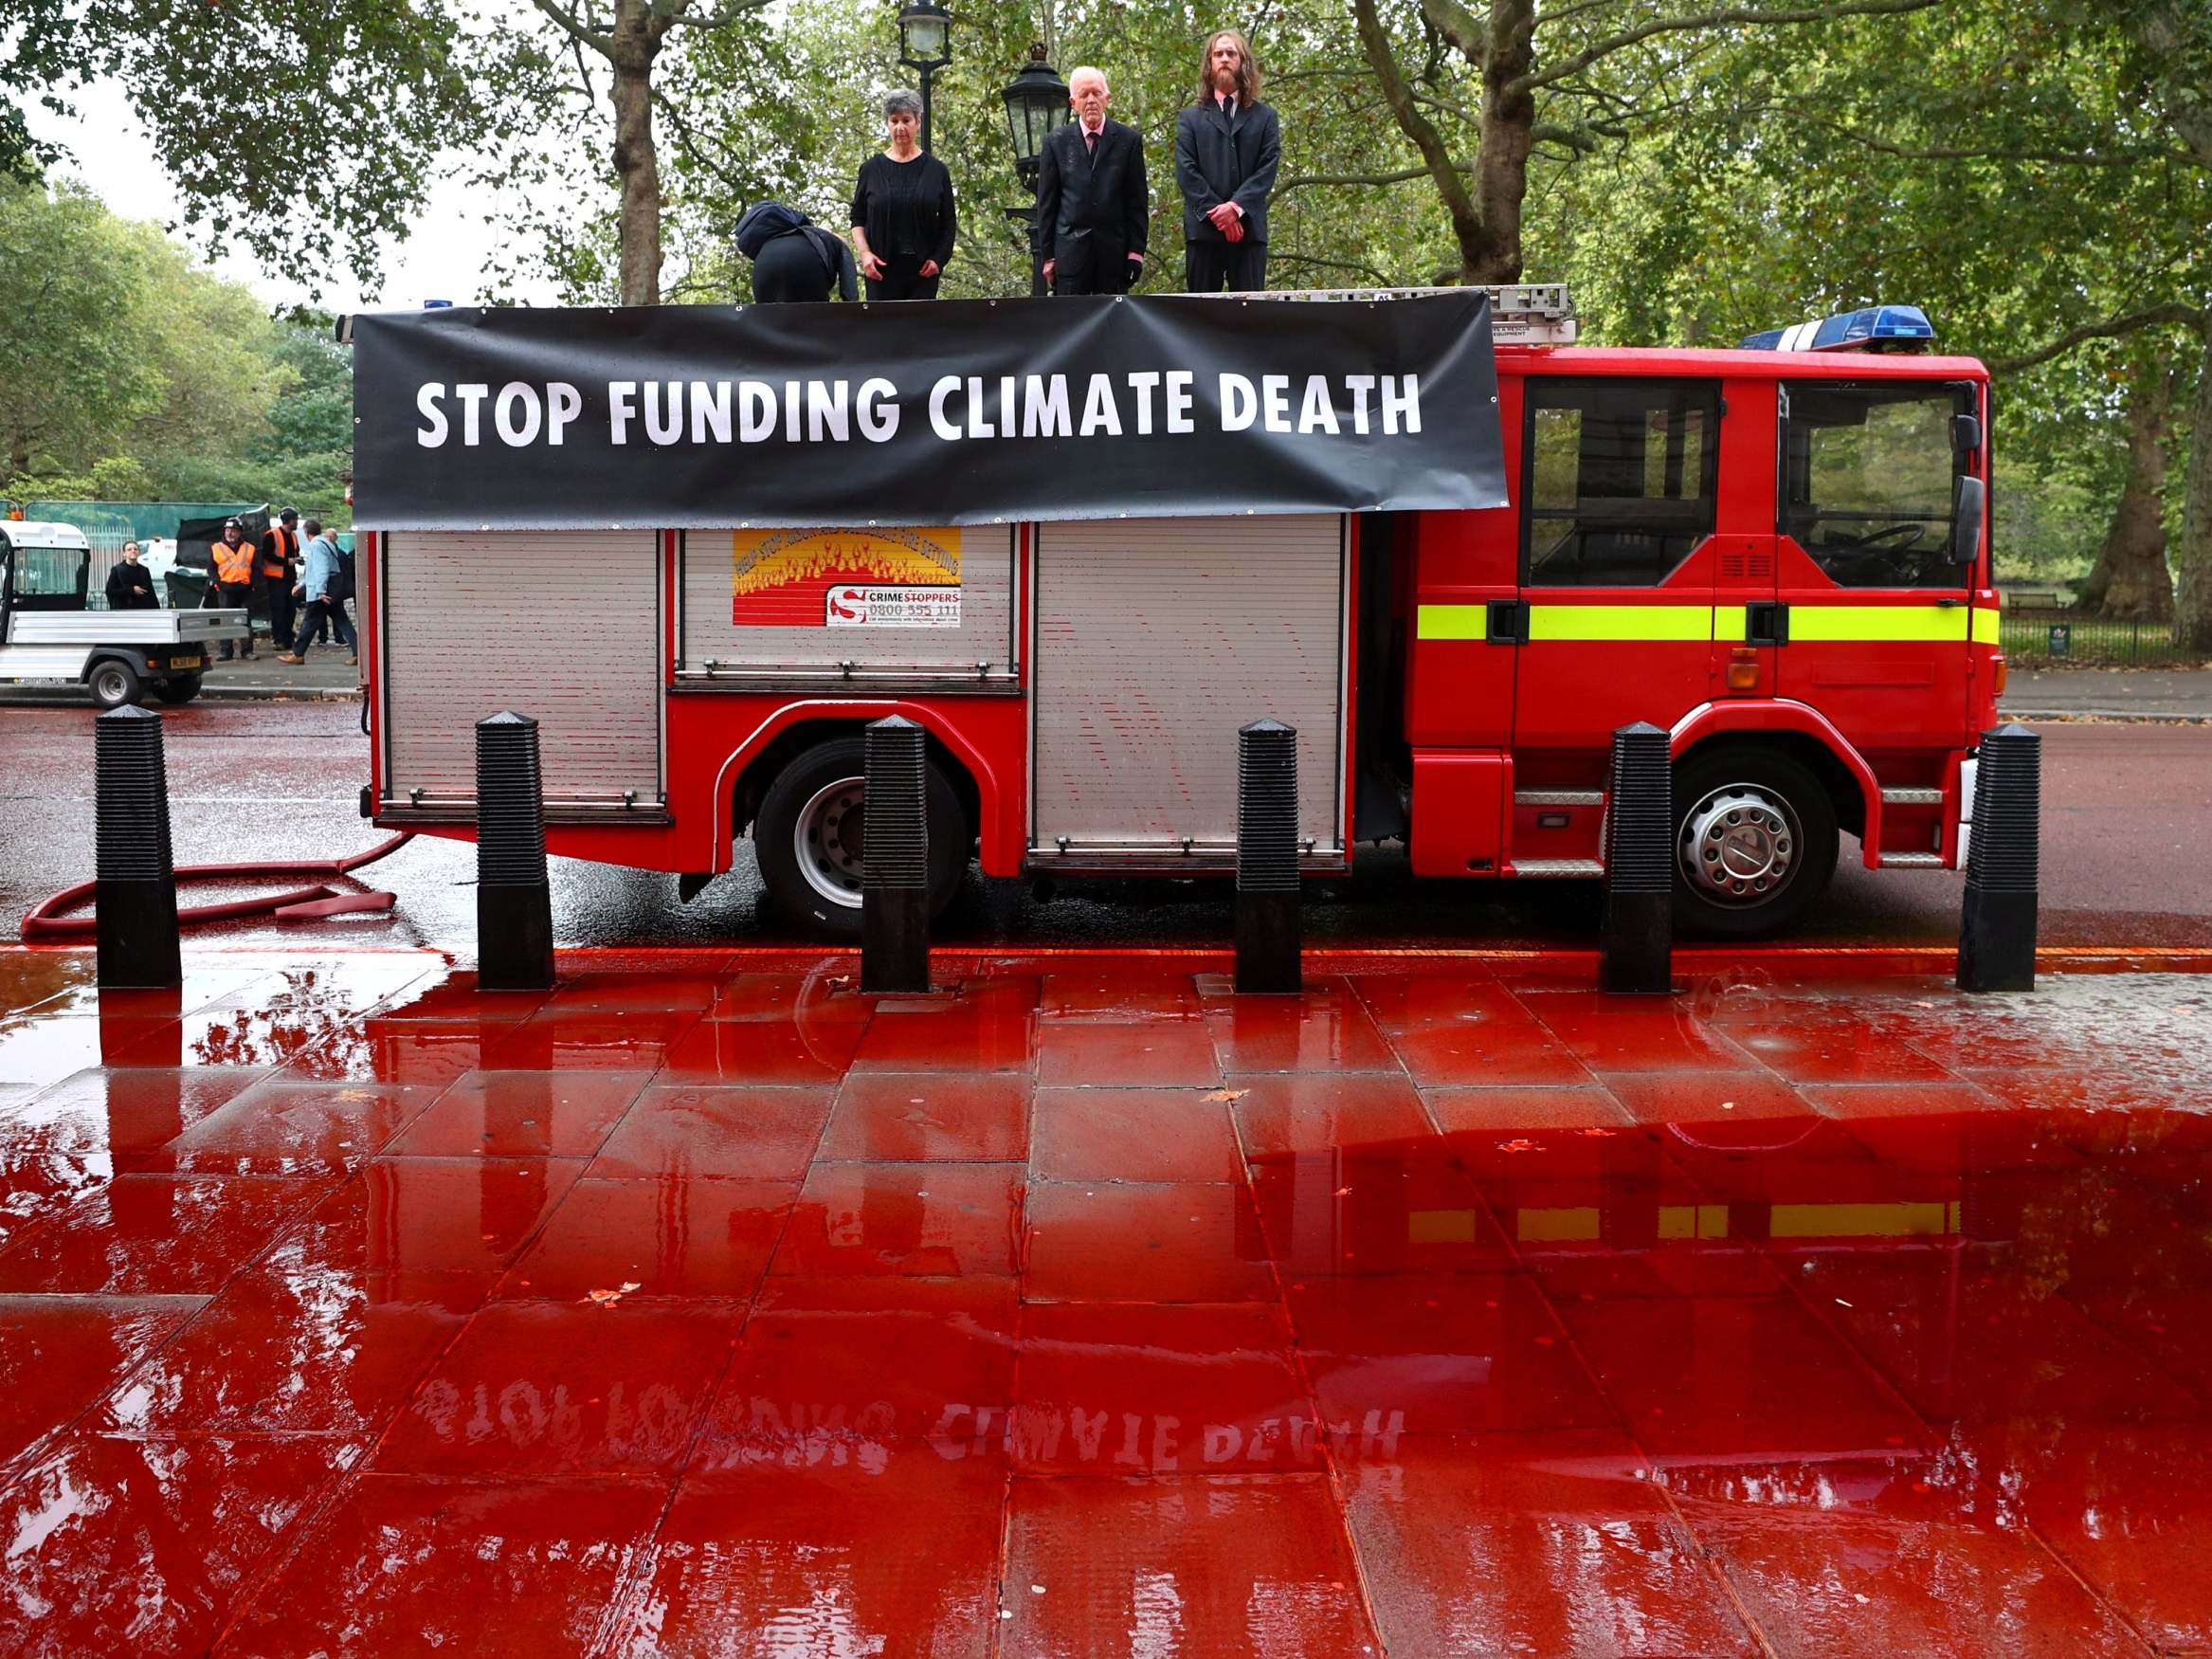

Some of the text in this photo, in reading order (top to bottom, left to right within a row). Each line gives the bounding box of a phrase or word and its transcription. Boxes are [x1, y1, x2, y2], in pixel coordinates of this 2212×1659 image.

[417, 371, 1422, 447] STOP FUNDING CLIMATE DEATH
[759, 533, 782, 561] STOP
[921, 538, 958, 576] SETTING
[869, 592, 959, 603] CRIMESTOPPERS
[869, 605, 958, 615] 0800 555 111
